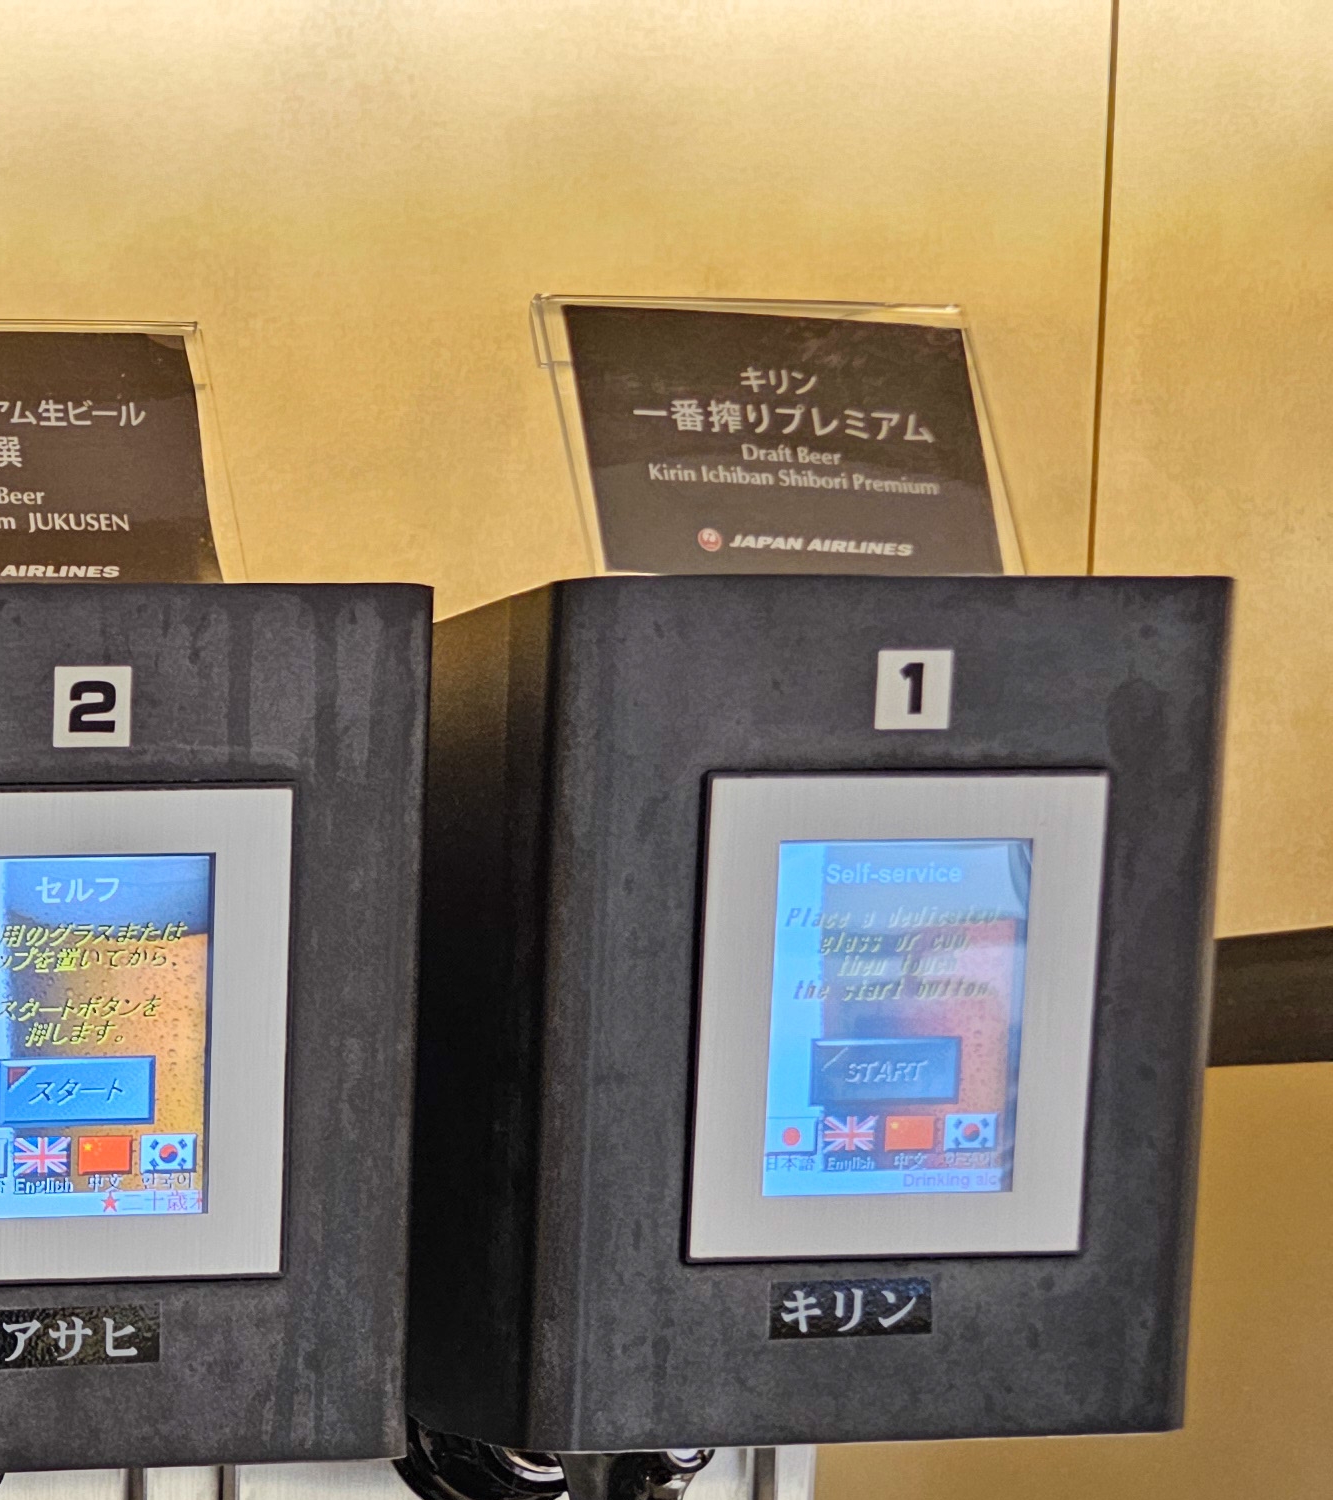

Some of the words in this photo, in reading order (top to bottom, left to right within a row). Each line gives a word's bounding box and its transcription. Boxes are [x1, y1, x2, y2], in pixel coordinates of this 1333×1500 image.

[739, 367, 817, 394] キリン
[633, 399, 934, 443] 一番搾りプレミアム
[741, 443, 792, 463] Draft
[796, 446, 841, 466] Beer
[648, 463, 697, 482] Kirin
[701, 466, 774, 486] Ichiban
[778, 469, 848, 489] Shibori
[852, 474, 940, 495] Premium
[28, 513, 130, 533] JUKUSEN
[729, 534, 803, 551] JAPAN
[806, 537, 914, 557] AIRLINES
[0, 564, 120, 578] AIRLINES
[898, 662, 924, 714] 1
[68, 680, 117, 733] 2
[826, 863, 963, 884] Self-service
[35, 876, 120, 904] セルフ
[786, 907, 852, 928] Place
[793, 980, 829, 1000] the
[845, 1060, 929, 1083] START
[29, 1079, 124, 1105] スタート
[903, 1172, 970, 1188] Drinking
[781, 1288, 917, 1333] キリン
[2, 1316, 138, 1362] アサヒ
